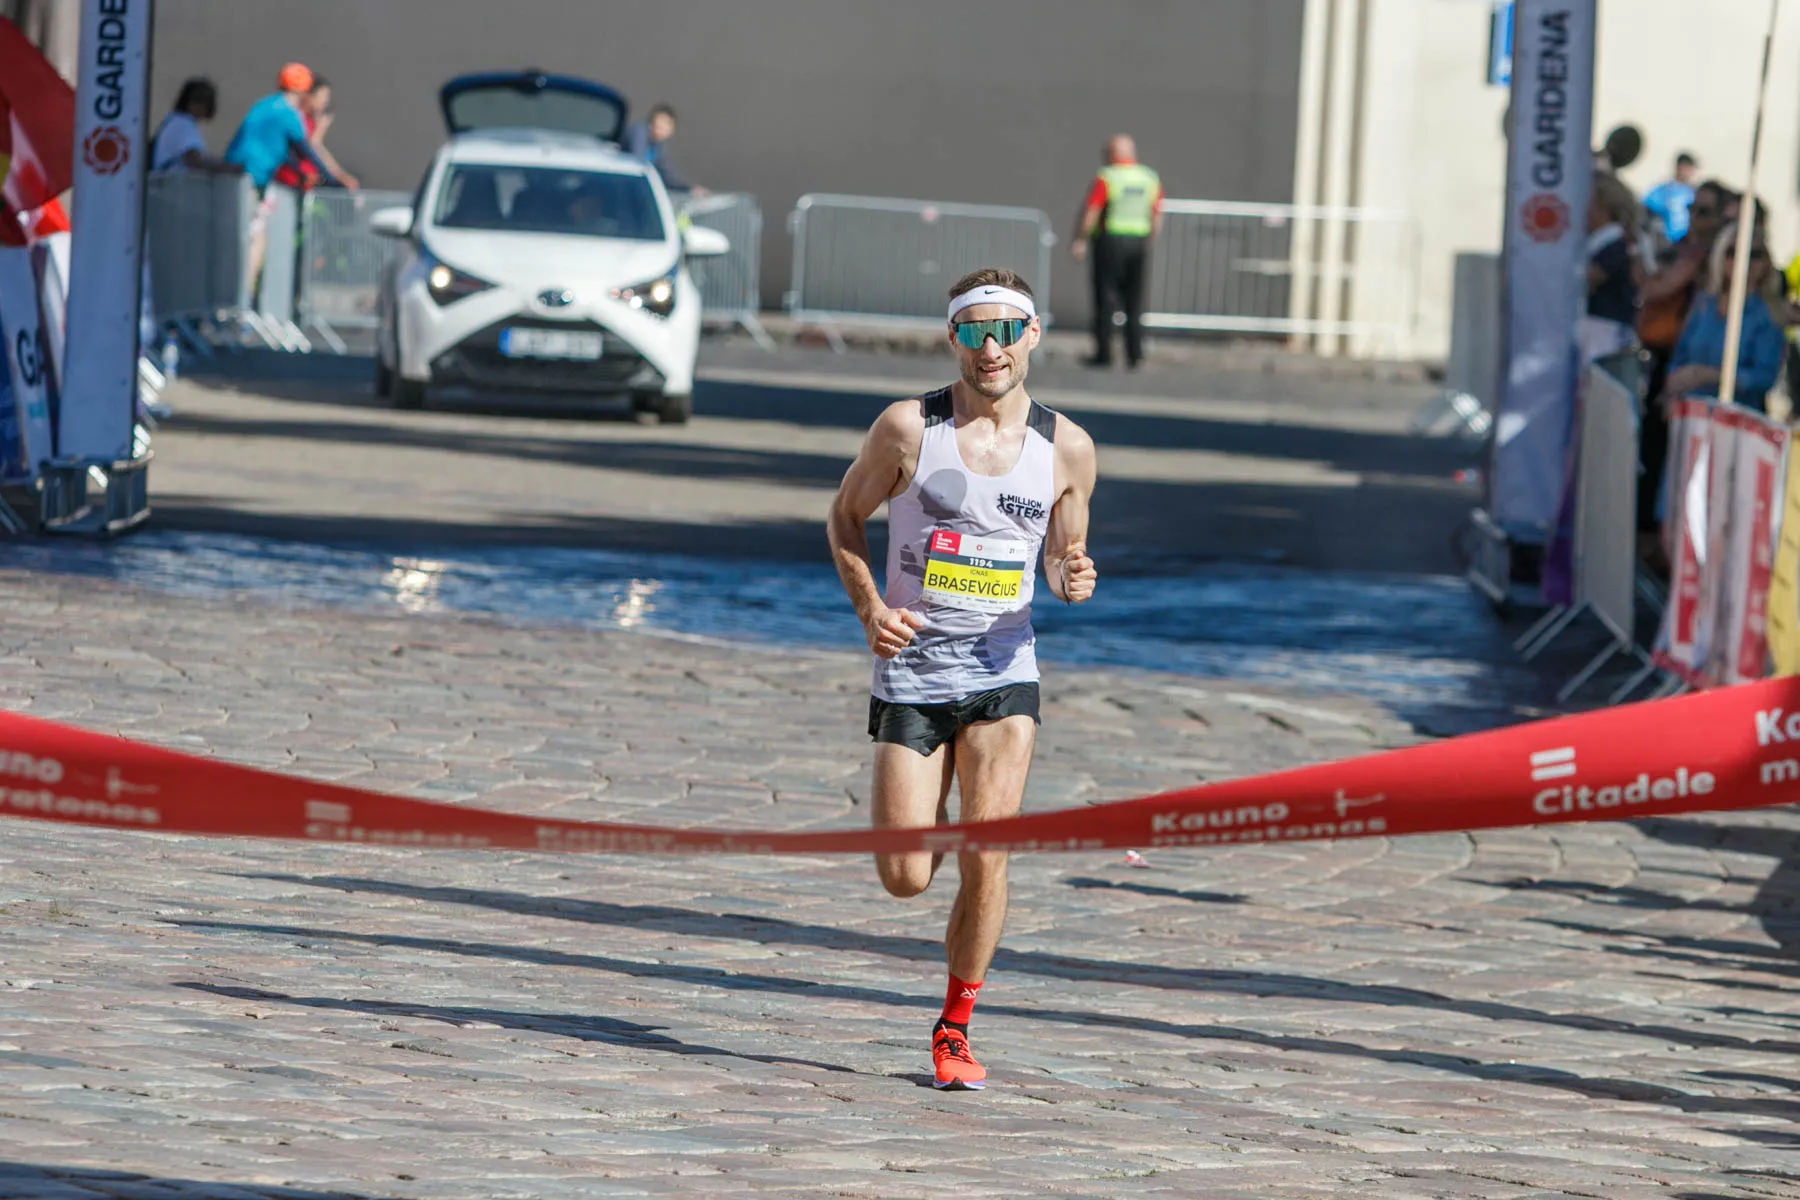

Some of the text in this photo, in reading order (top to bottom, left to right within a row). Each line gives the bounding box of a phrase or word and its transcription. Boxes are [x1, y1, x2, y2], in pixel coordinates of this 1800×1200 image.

[1532, 9, 1571, 190] GARDENA
[1005, 502, 1047, 520] STEPS
[1006, 494, 1042, 509] MILLION
[969, 557, 994, 568] 1194
[969, 568, 989, 577] IGNAS
[927, 572, 1018, 597] BRASEVIČIUS
[1533, 766, 1716, 816] Citadele
[1151, 802, 1290, 833] Kauno
